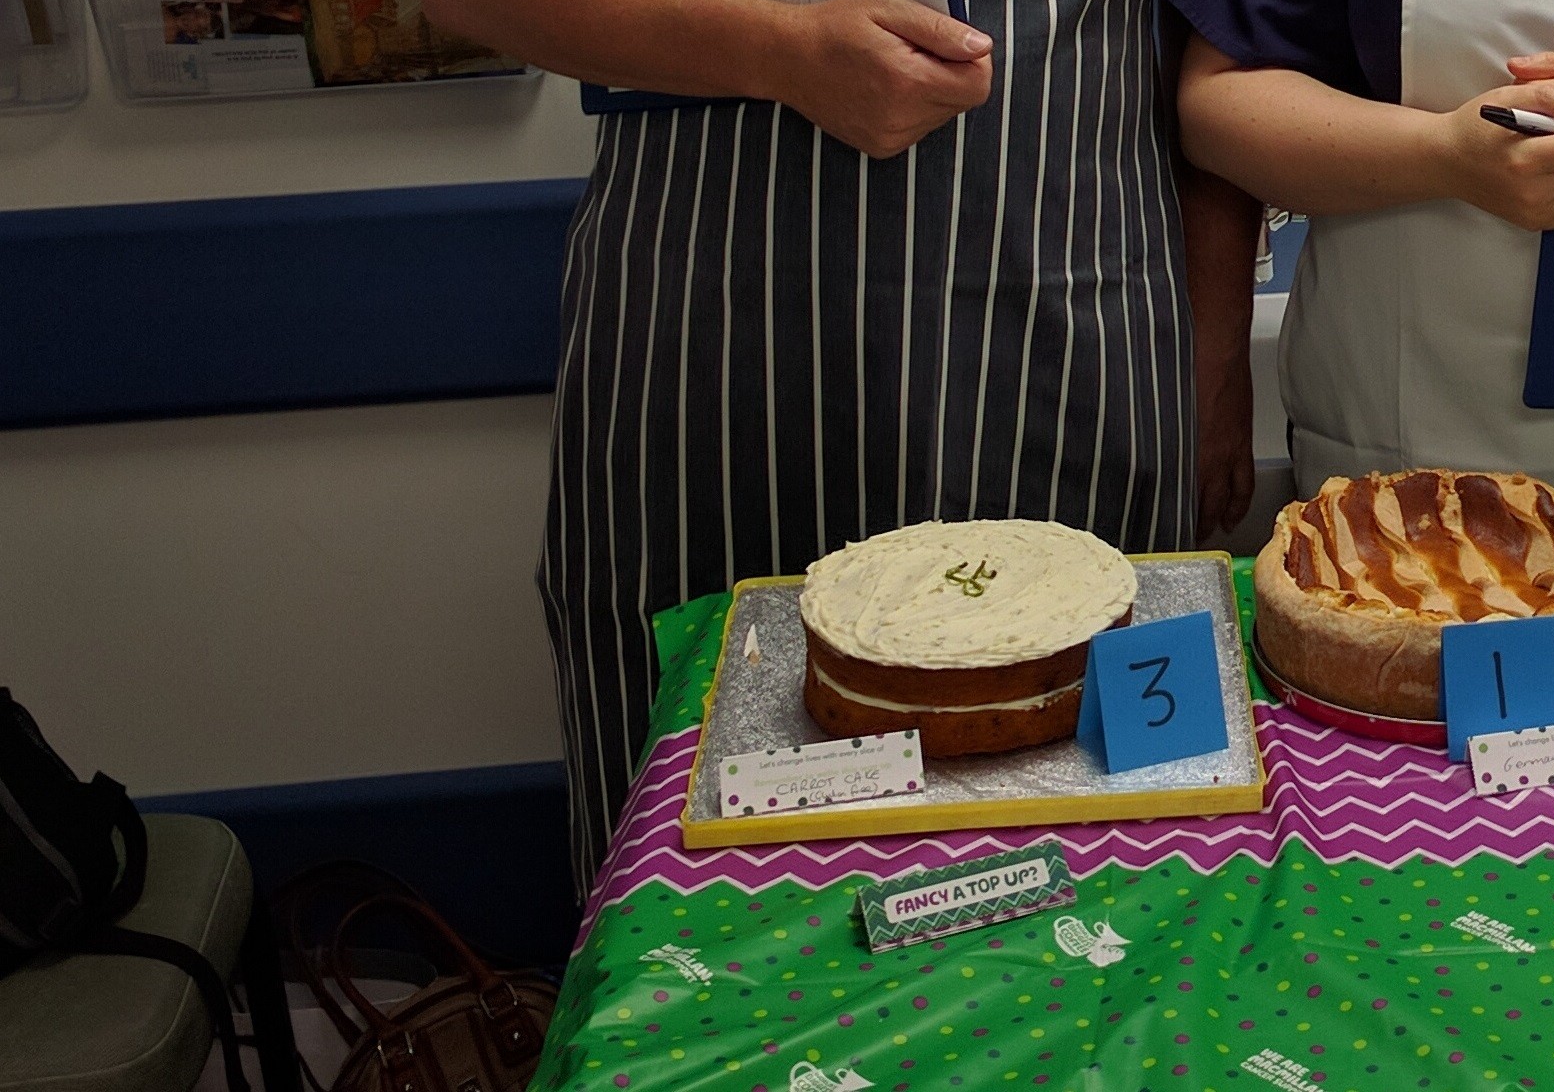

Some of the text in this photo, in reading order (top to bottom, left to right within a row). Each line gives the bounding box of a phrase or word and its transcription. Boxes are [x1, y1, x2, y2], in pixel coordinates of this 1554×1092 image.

[1128, 656, 1176, 727] 3
[1508, 739, 1524, 748] Let's
[1525, 736, 1550, 747] change
[759, 744, 885, 769] Let's change lives with every slice of
[776, 776, 835, 796] CARROT
[844, 769, 880, 785] CAKE
[895, 866, 1038, 916] FANCY A TOP UP?
[1467, 910, 1515, 934] WE ARE
[1260, 1048, 1310, 1077] WE ARE
